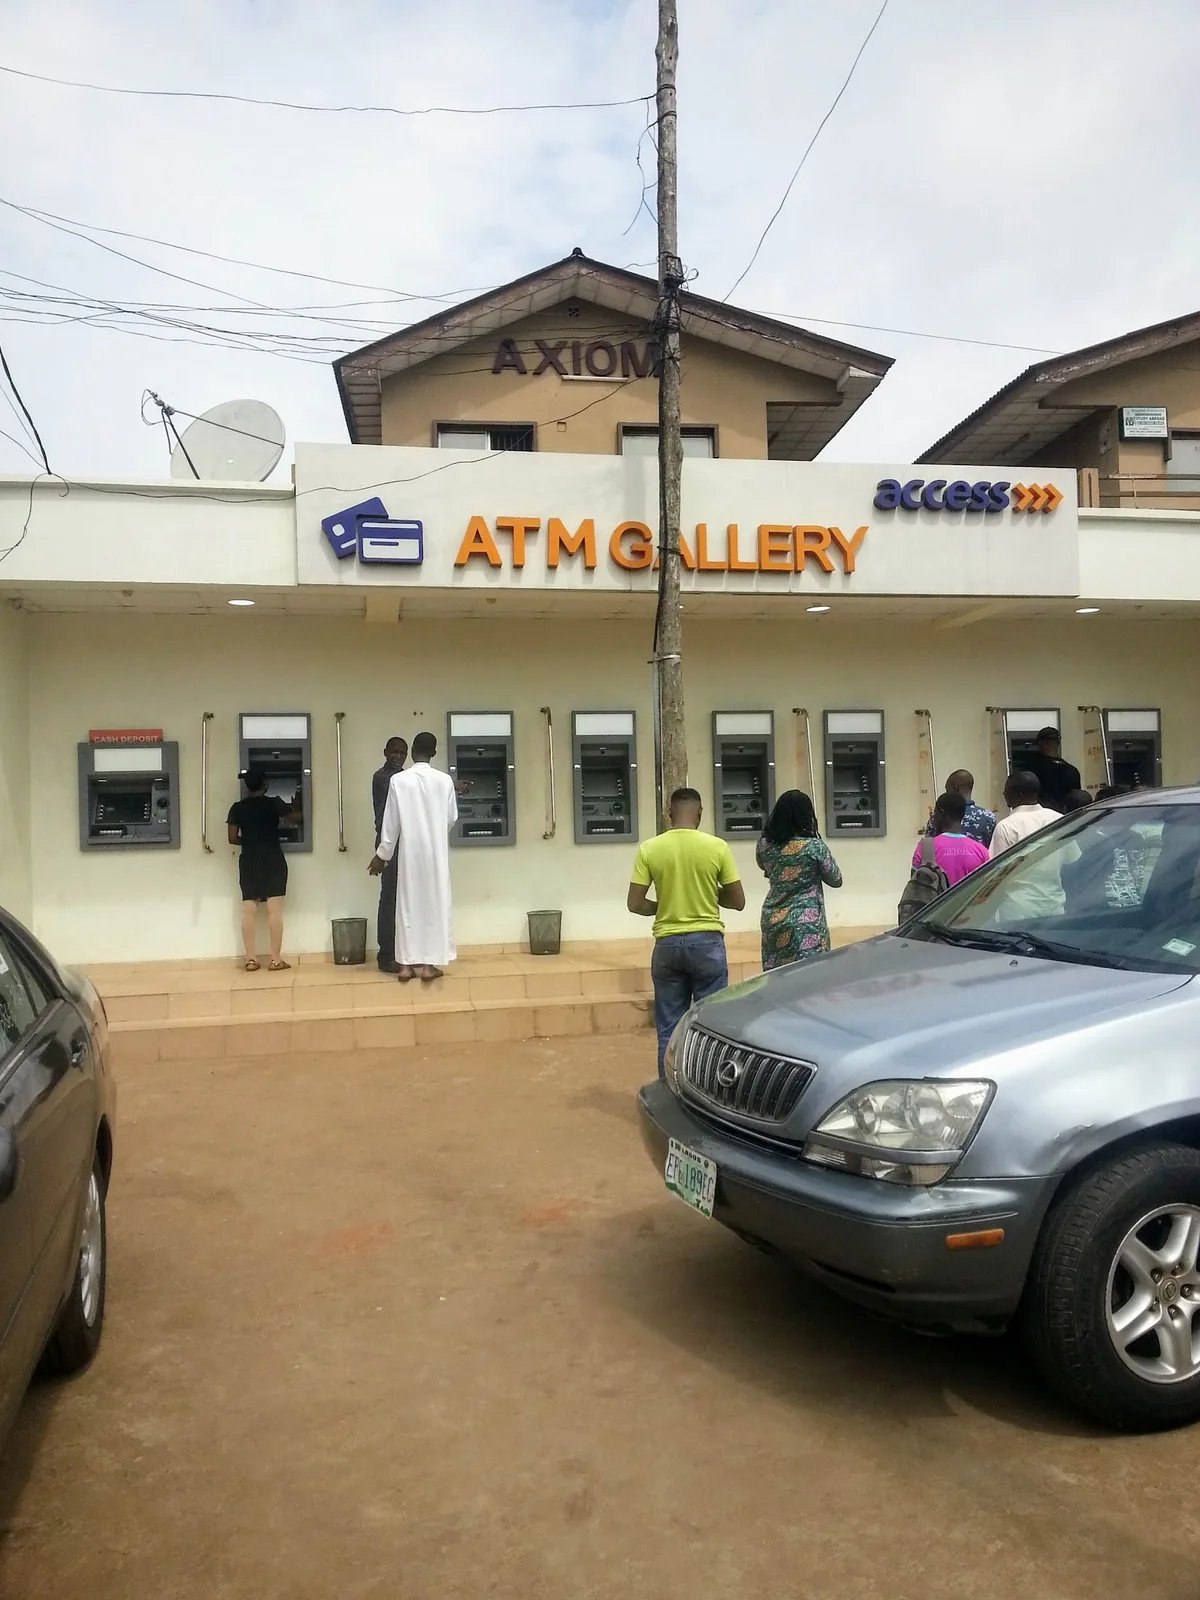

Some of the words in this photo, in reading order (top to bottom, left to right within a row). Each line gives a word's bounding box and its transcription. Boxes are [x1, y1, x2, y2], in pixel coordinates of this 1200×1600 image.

[492, 339, 661, 378] AXIOM
[873, 479, 1011, 513] access
[454, 516, 597, 569] ATM
[120, 735, 159, 743] DEPOSIT
